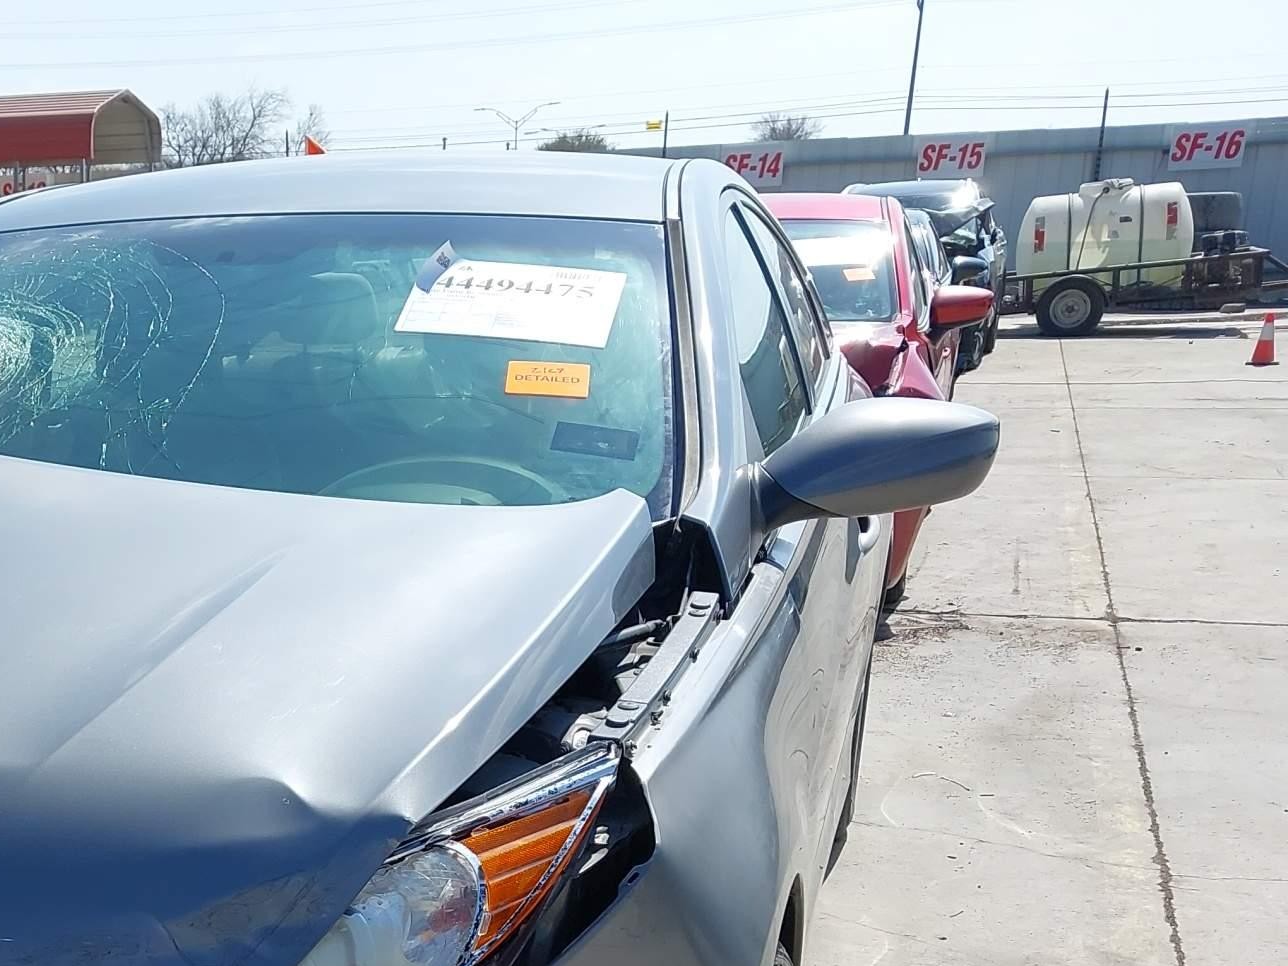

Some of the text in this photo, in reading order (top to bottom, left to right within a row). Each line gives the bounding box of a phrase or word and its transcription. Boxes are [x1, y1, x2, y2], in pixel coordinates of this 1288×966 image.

[918, 142, 985, 172] SF-15
[1170, 129, 1246, 163] SF-16
[724, 151, 783, 179] SF-14
[436, 275, 596, 300] 44494475
[514, 374, 581, 385] DETAILED
